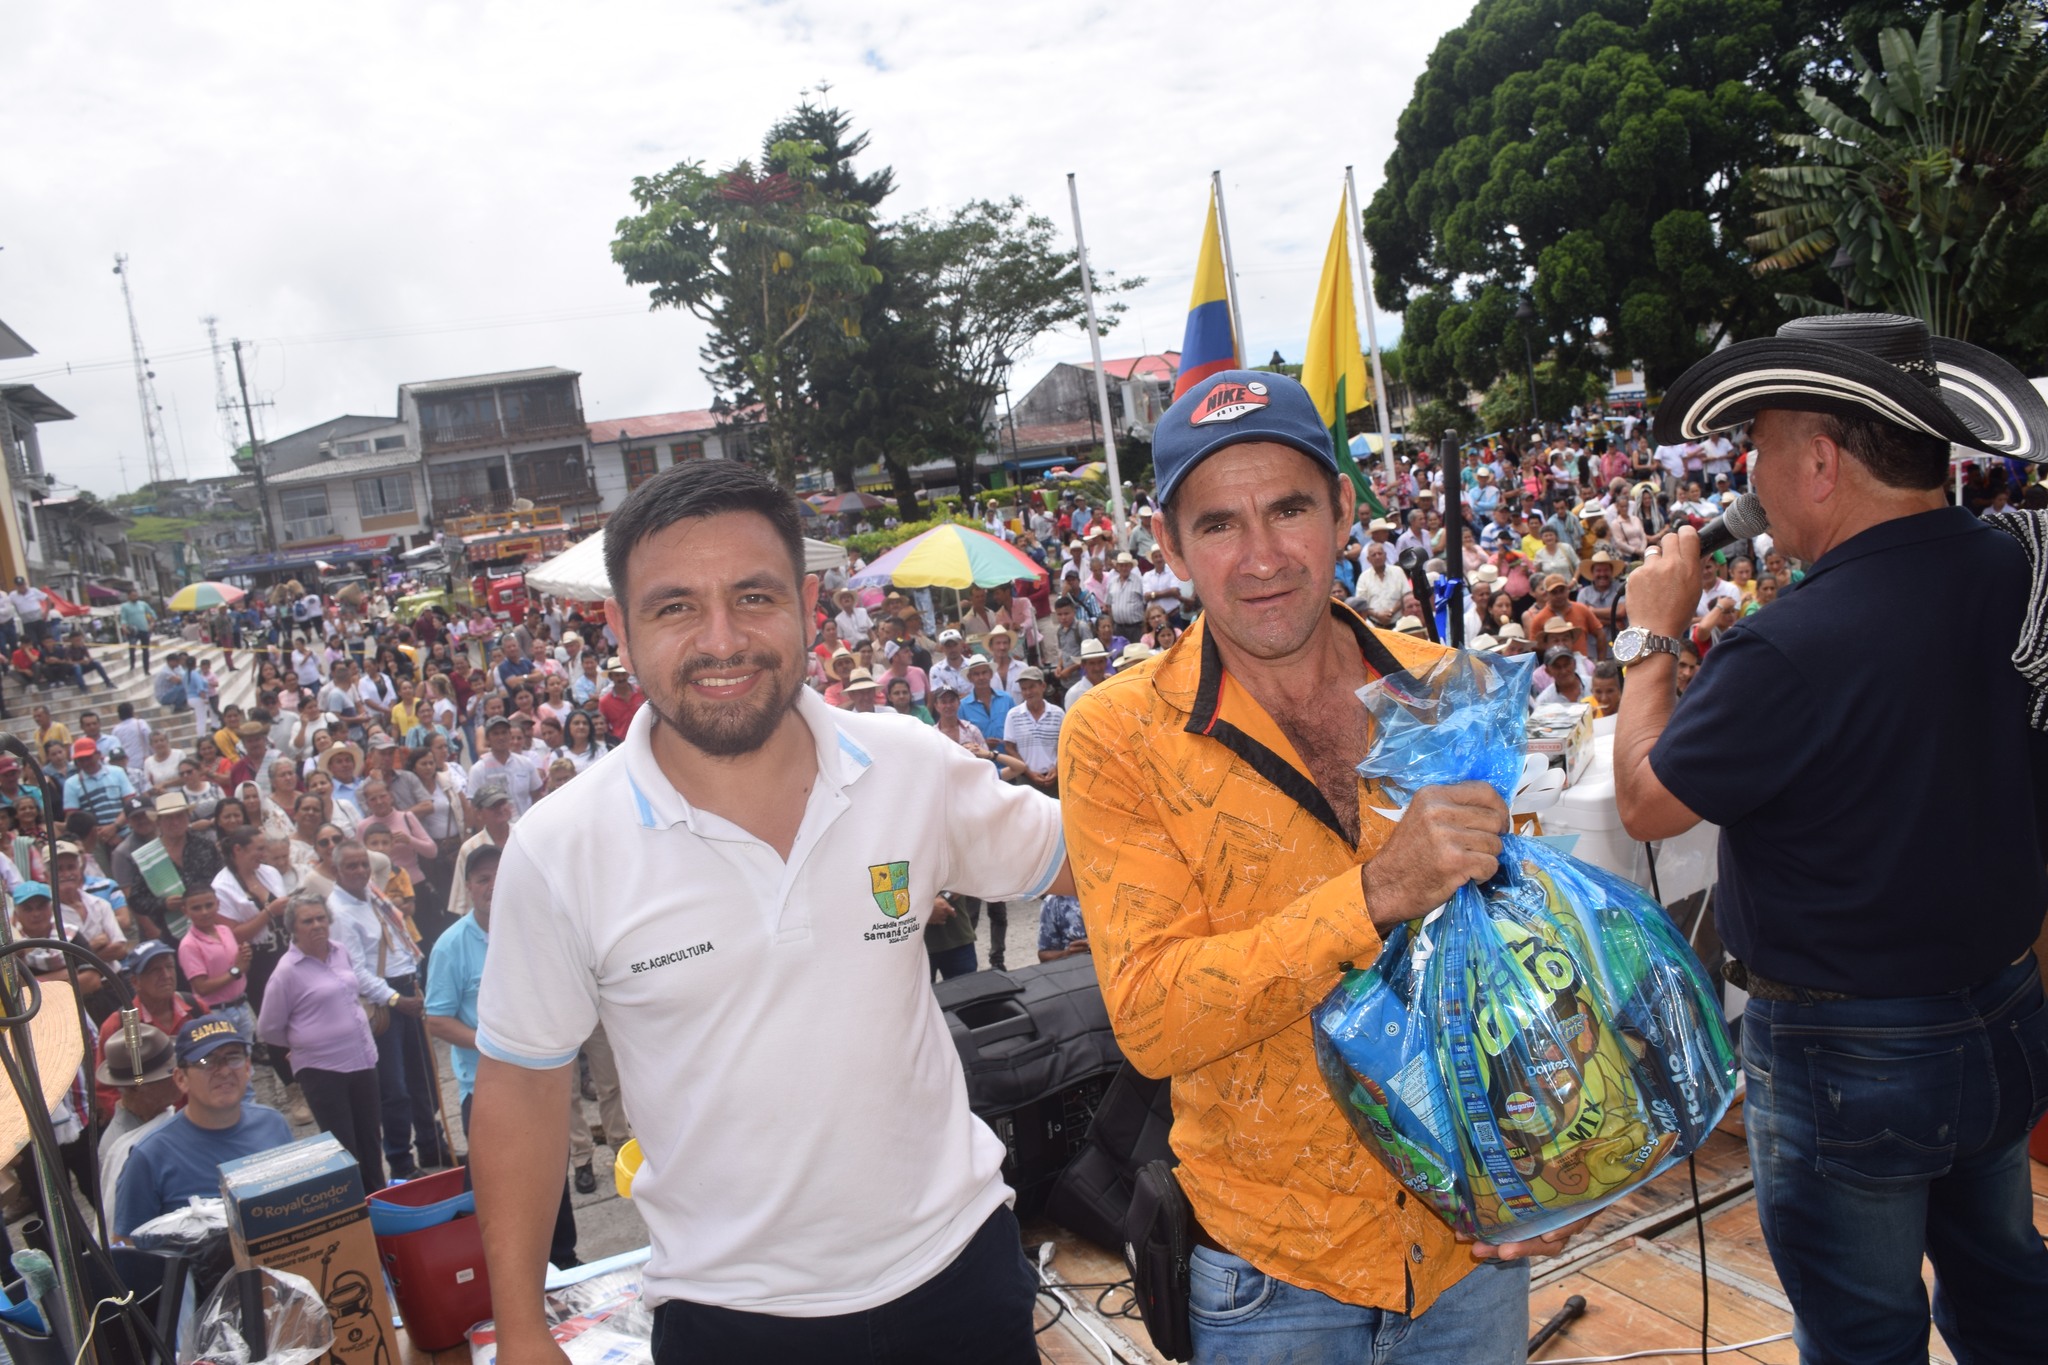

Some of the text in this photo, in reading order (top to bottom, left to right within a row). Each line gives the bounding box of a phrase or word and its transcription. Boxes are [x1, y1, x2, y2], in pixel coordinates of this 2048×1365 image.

[1206, 387, 1246, 412] NIKE
[1526, 1058, 1570, 1077] Doritos
[1668, 1054, 1705, 1126] italo
[1507, 1101, 1536, 1113] Margarita
[1566, 1099, 1601, 1141] MIX
[1635, 1144, 1653, 1163] 165
[265, 1183, 349, 1218] RoyalCondor
[260, 1212, 359, 1250] MANUAL PRESSURE SPRAYER
